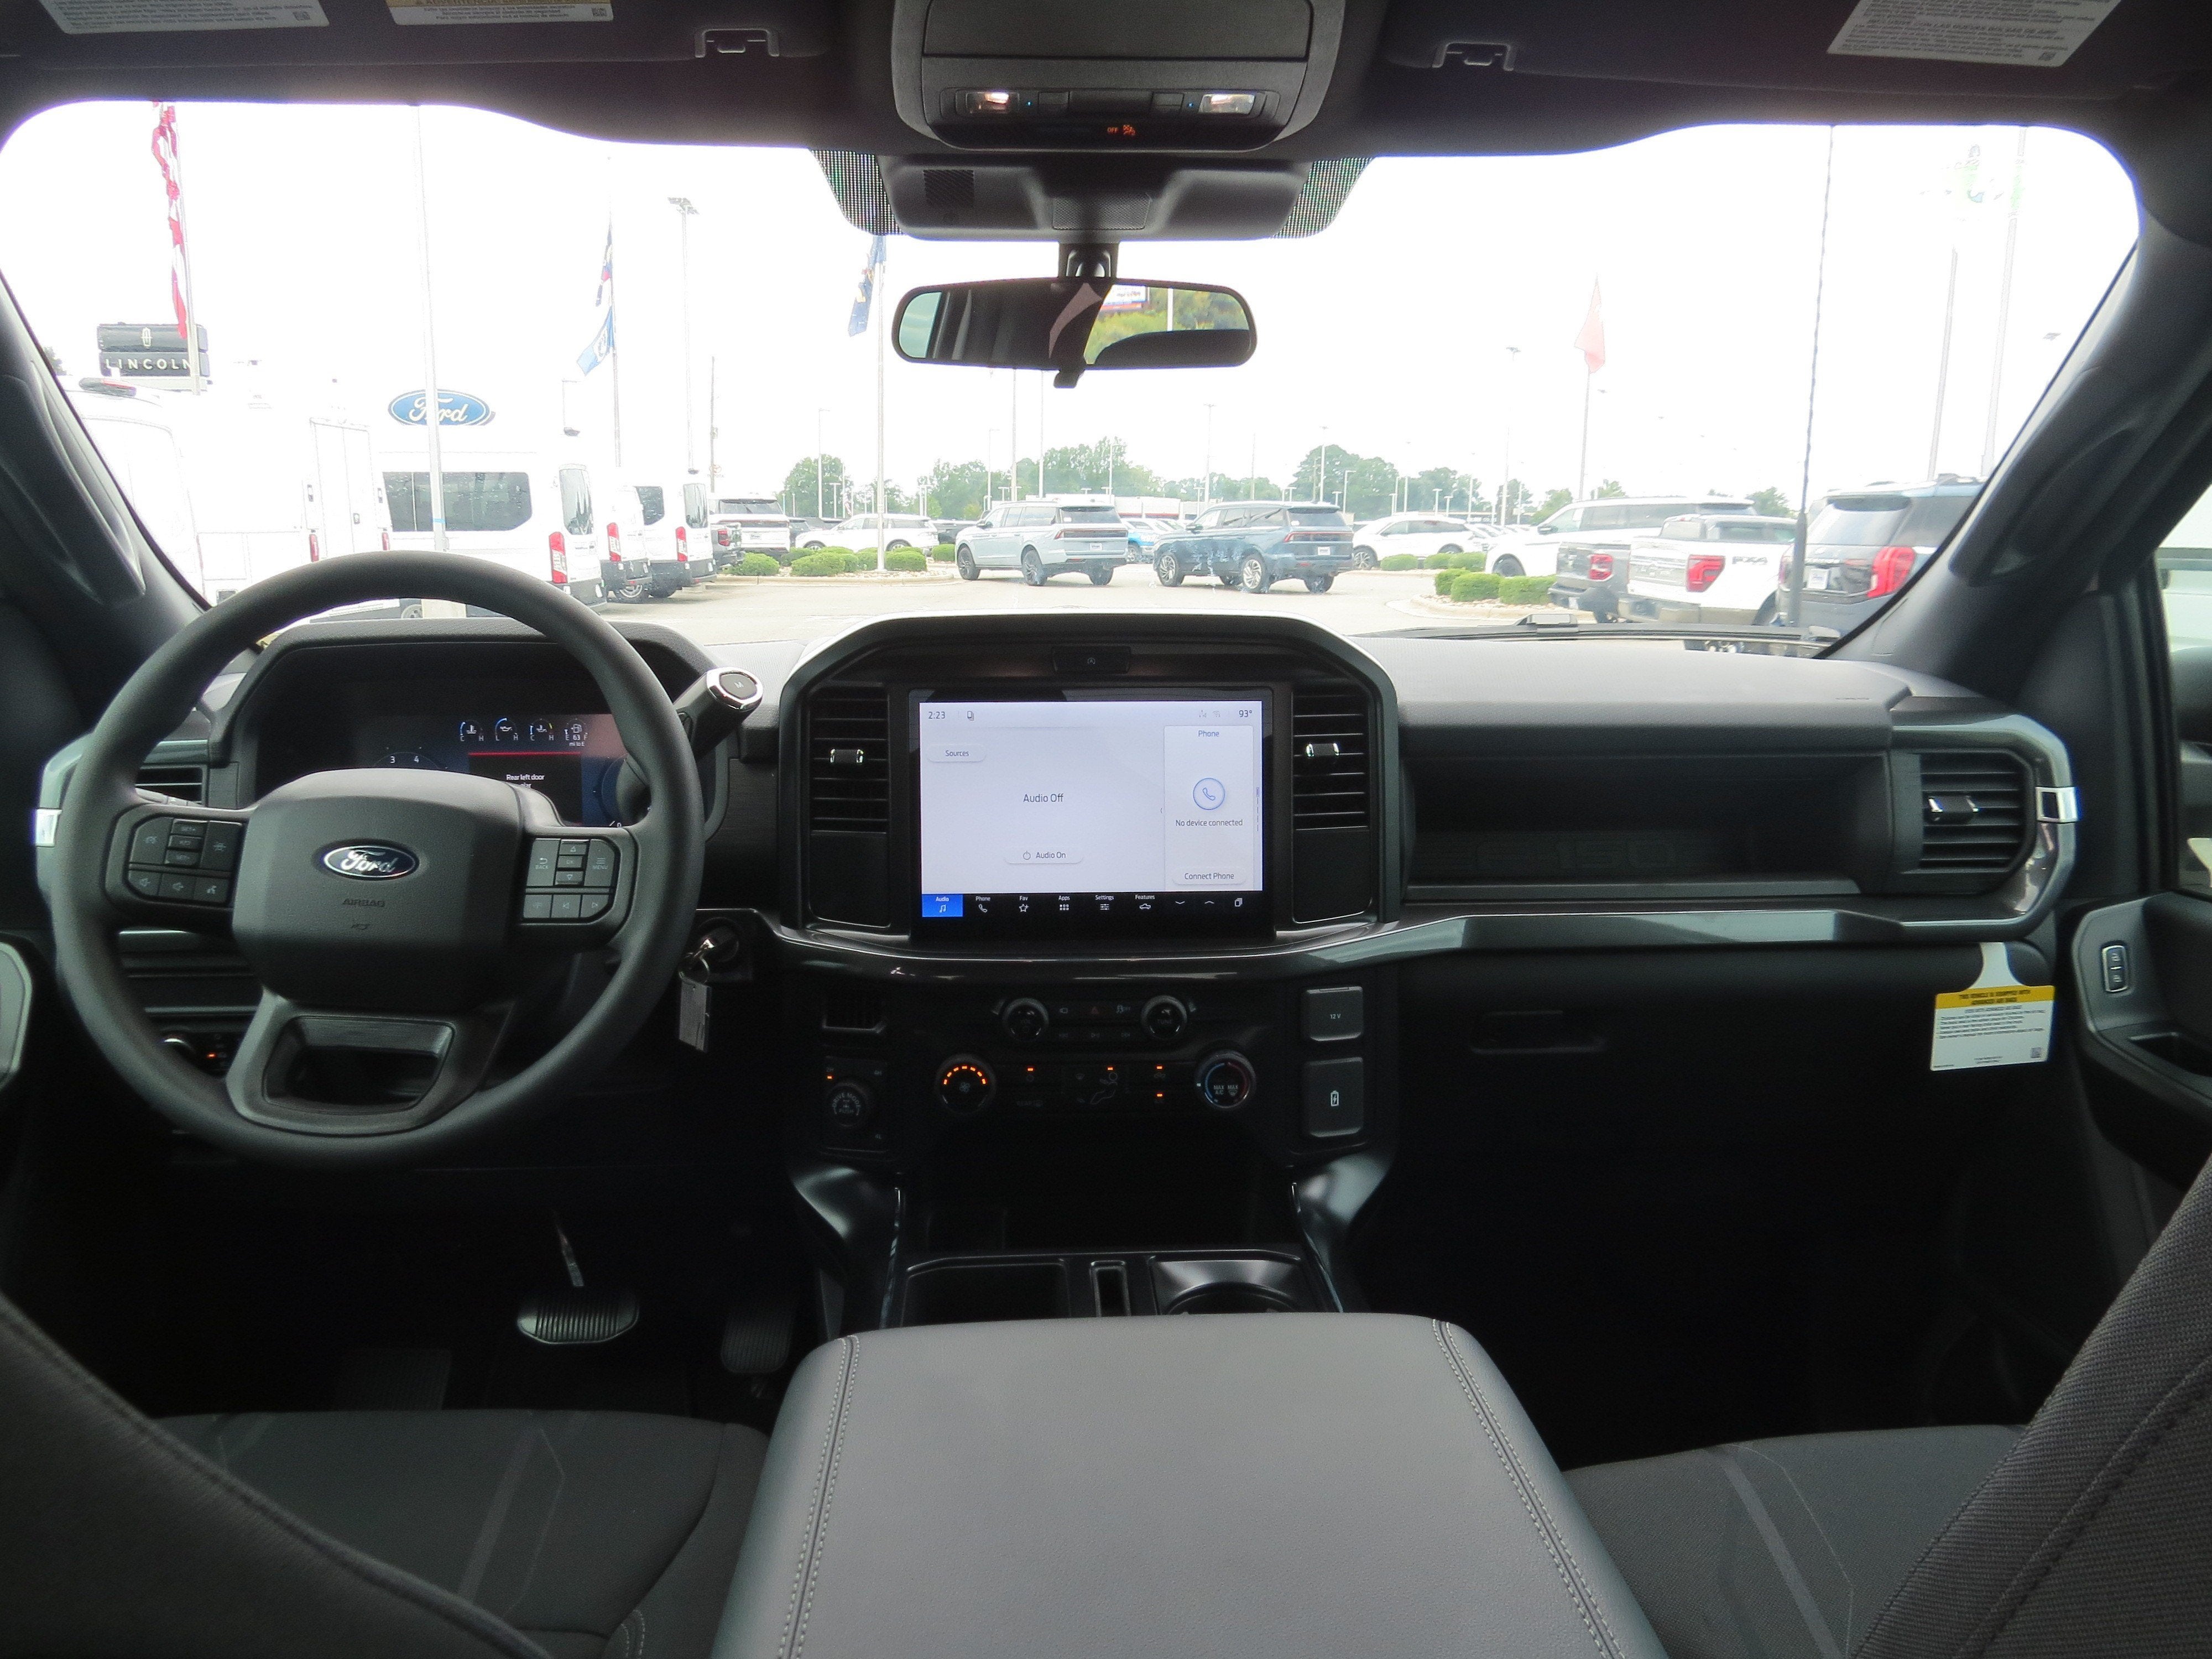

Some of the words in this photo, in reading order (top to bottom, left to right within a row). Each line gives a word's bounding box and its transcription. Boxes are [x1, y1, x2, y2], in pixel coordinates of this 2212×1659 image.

[105, 358, 190, 369] LINCOLN
[409, 397, 468, 422] Frd
[928, 711, 946, 719] 2:23
[1239, 709, 1253, 718] 93°
[1022, 794, 1048, 802] Audio
[1050, 793, 1064, 802] Off
[1186, 819, 1207, 827] device
[341, 849, 399, 873] Ford
[342, 898, 386, 907] AIRBAG
[832, 1092, 845, 1108] DRIVE
